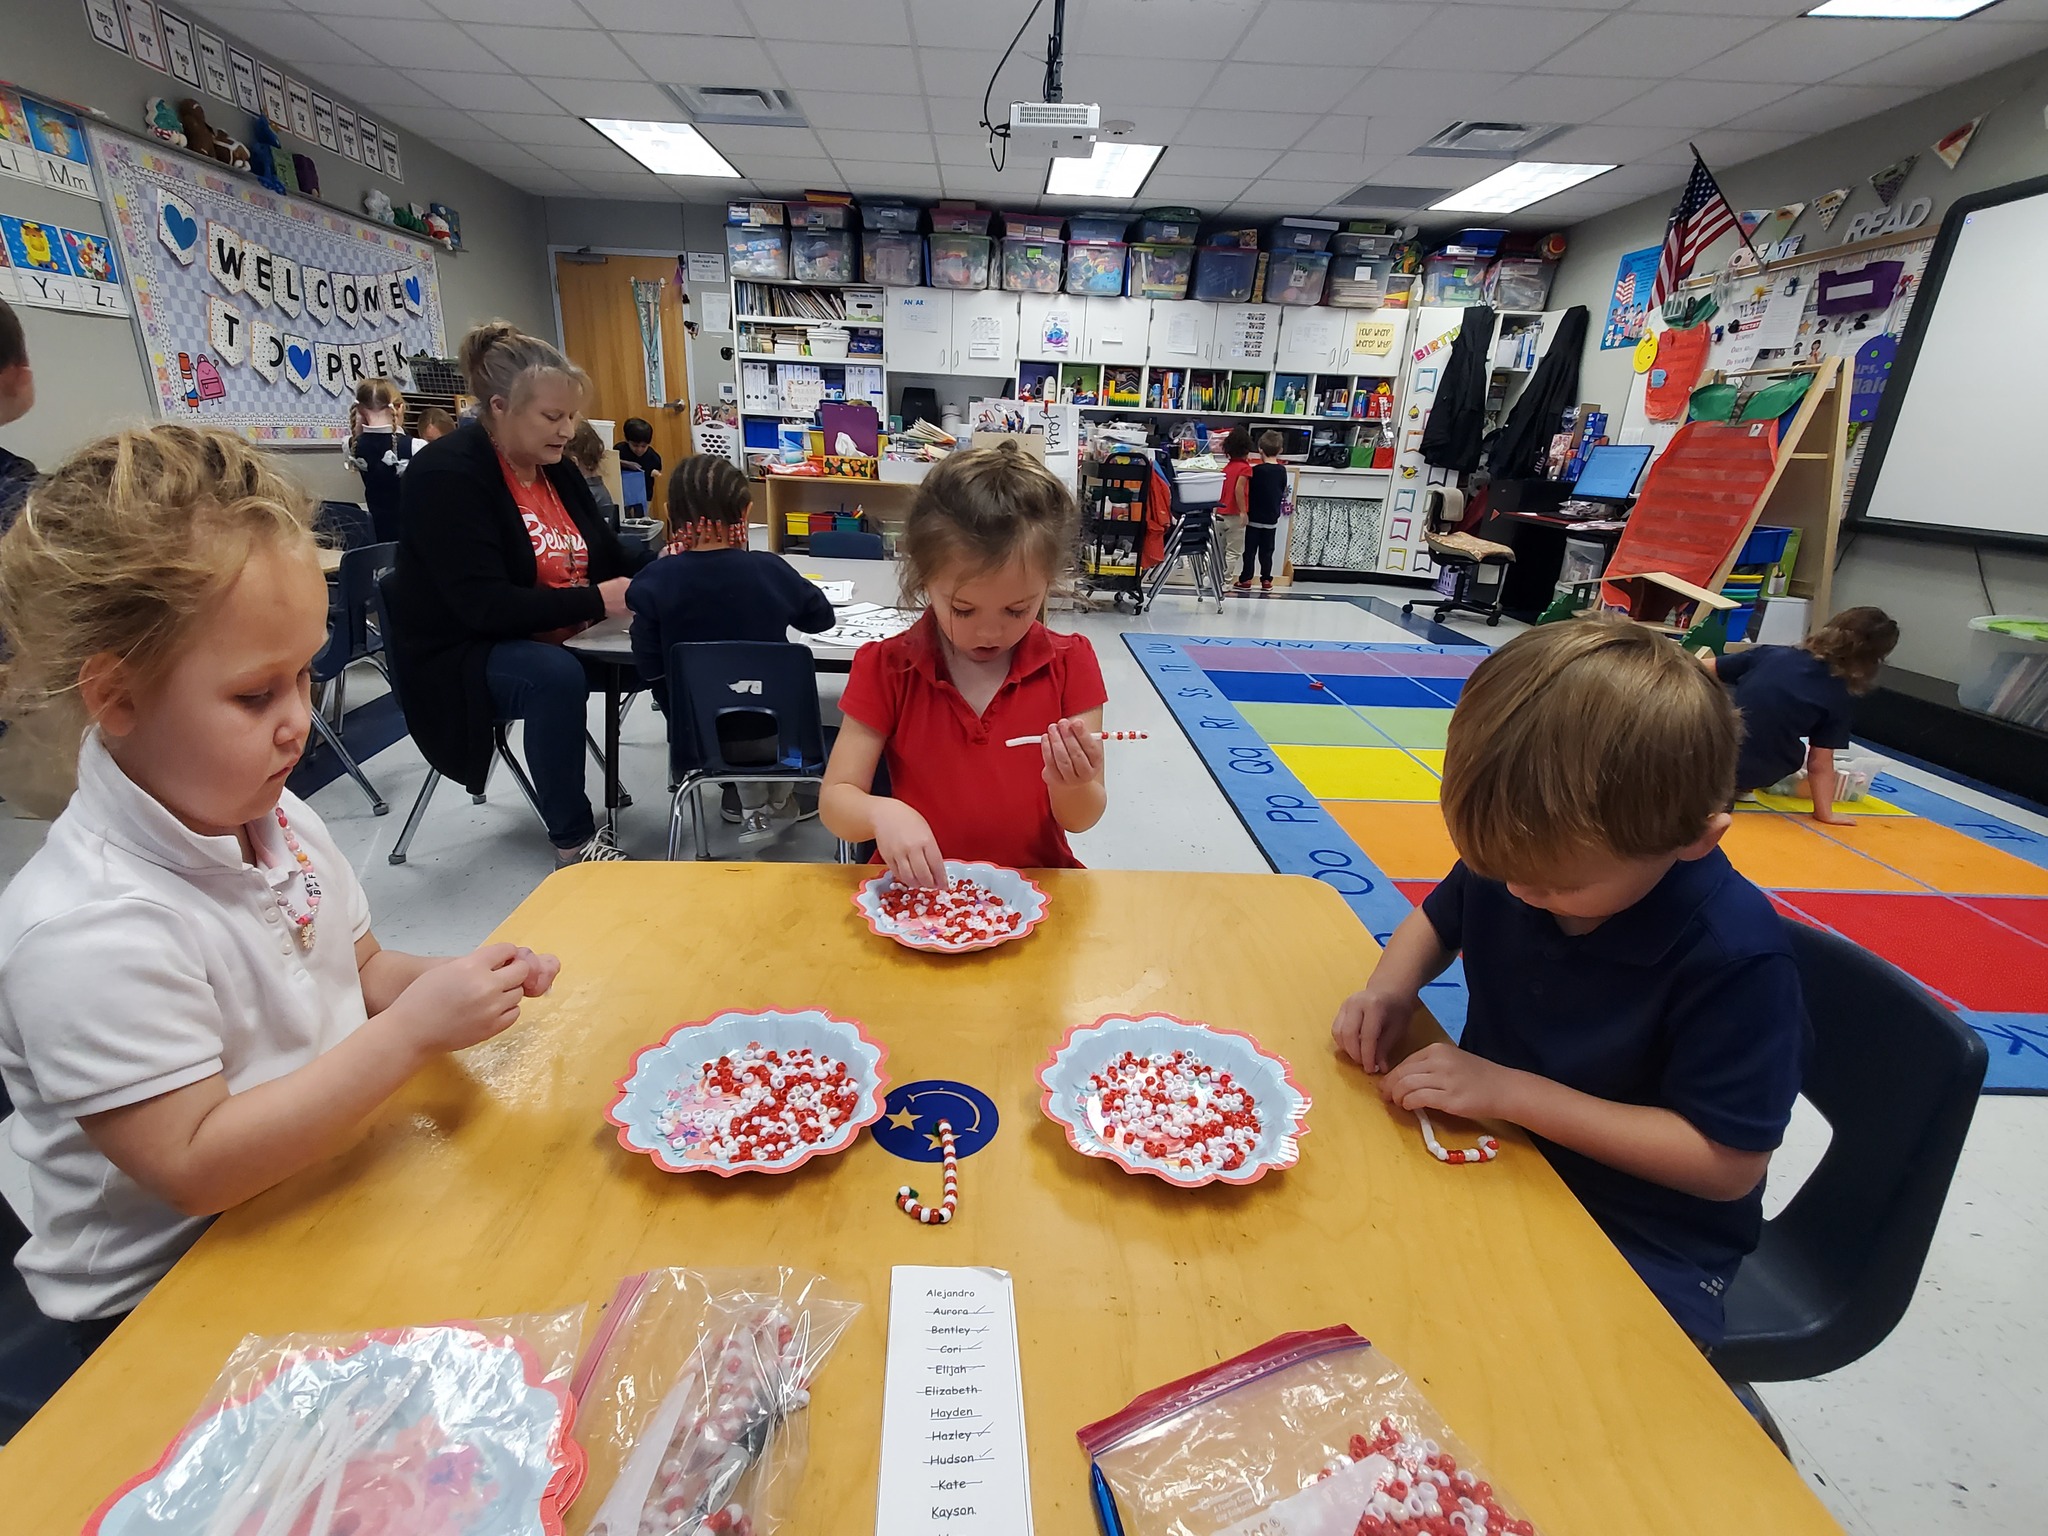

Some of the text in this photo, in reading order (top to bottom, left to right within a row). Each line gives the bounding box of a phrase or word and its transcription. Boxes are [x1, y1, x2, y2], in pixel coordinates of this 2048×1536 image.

[138, 32, 153, 47] one
[175, 49, 190, 66] two
[181, 64, 189, 77] 2
[1842, 197, 1932, 245] READ
[217, 238, 404, 314] WELCOME
[1413, 324, 1461, 361] BIRTH
[926, 1289, 975, 1299] Alejandro
[933, 1308, 969, 1316] Aurora
[931, 1326, 971, 1336] Bentley
[940, 1345, 962, 1354] Cori
[935, 1365, 967, 1375] Elijah
[925, 1386, 978, 1396] Elizabeth
[930, 1408, 974, 1419] Hayden
[932, 1430, 972, 1442] Hazley
[930, 1454, 975, 1466] Hudson
[938, 1480, 967, 1490] Kate
